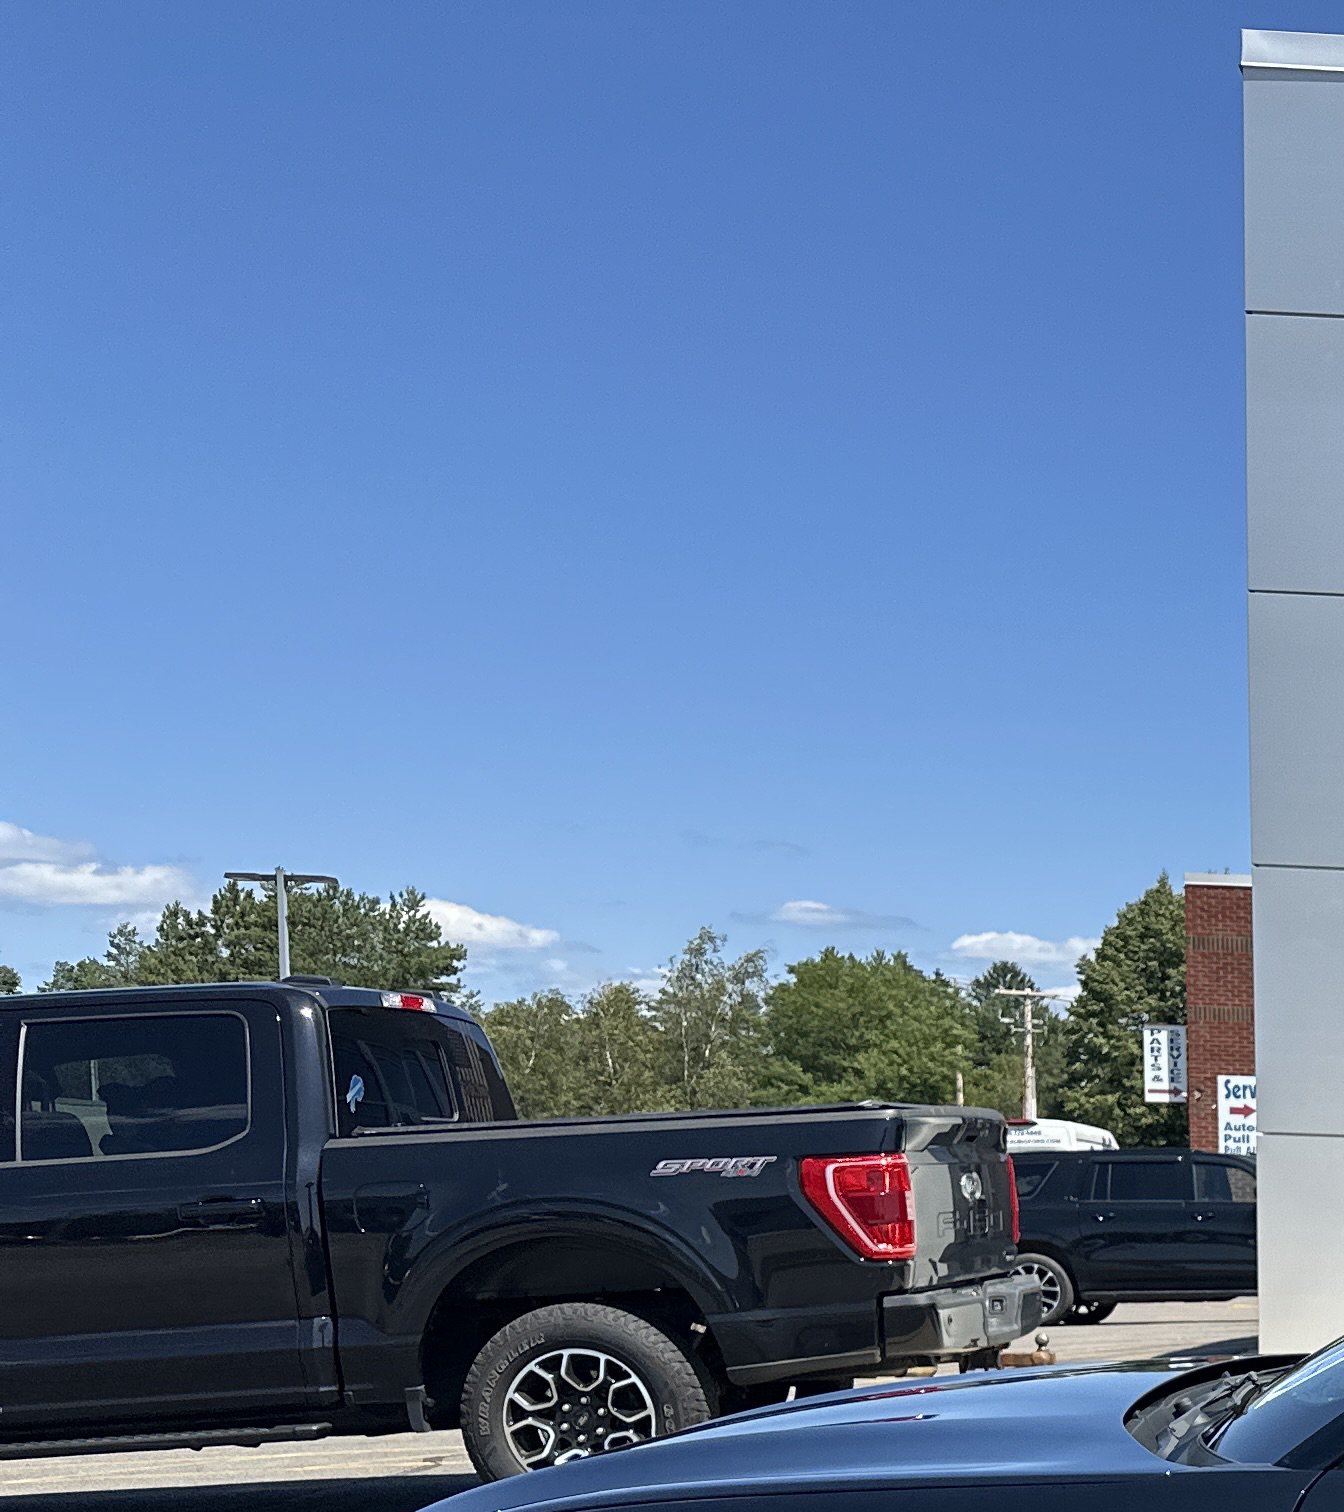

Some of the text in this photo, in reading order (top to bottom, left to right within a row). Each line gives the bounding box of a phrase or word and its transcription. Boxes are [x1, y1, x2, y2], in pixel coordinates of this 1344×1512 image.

[1150, 1029, 1162, 1071] PARTS
[1170, 1029, 1183, 1083] SERVICE
[1223, 1122, 1255, 1132] Auto
[1224, 1133, 1250, 1144] Pull
[650, 1156, 777, 1177] SPORT
[479, 1333, 545, 1435] WRANGLER
